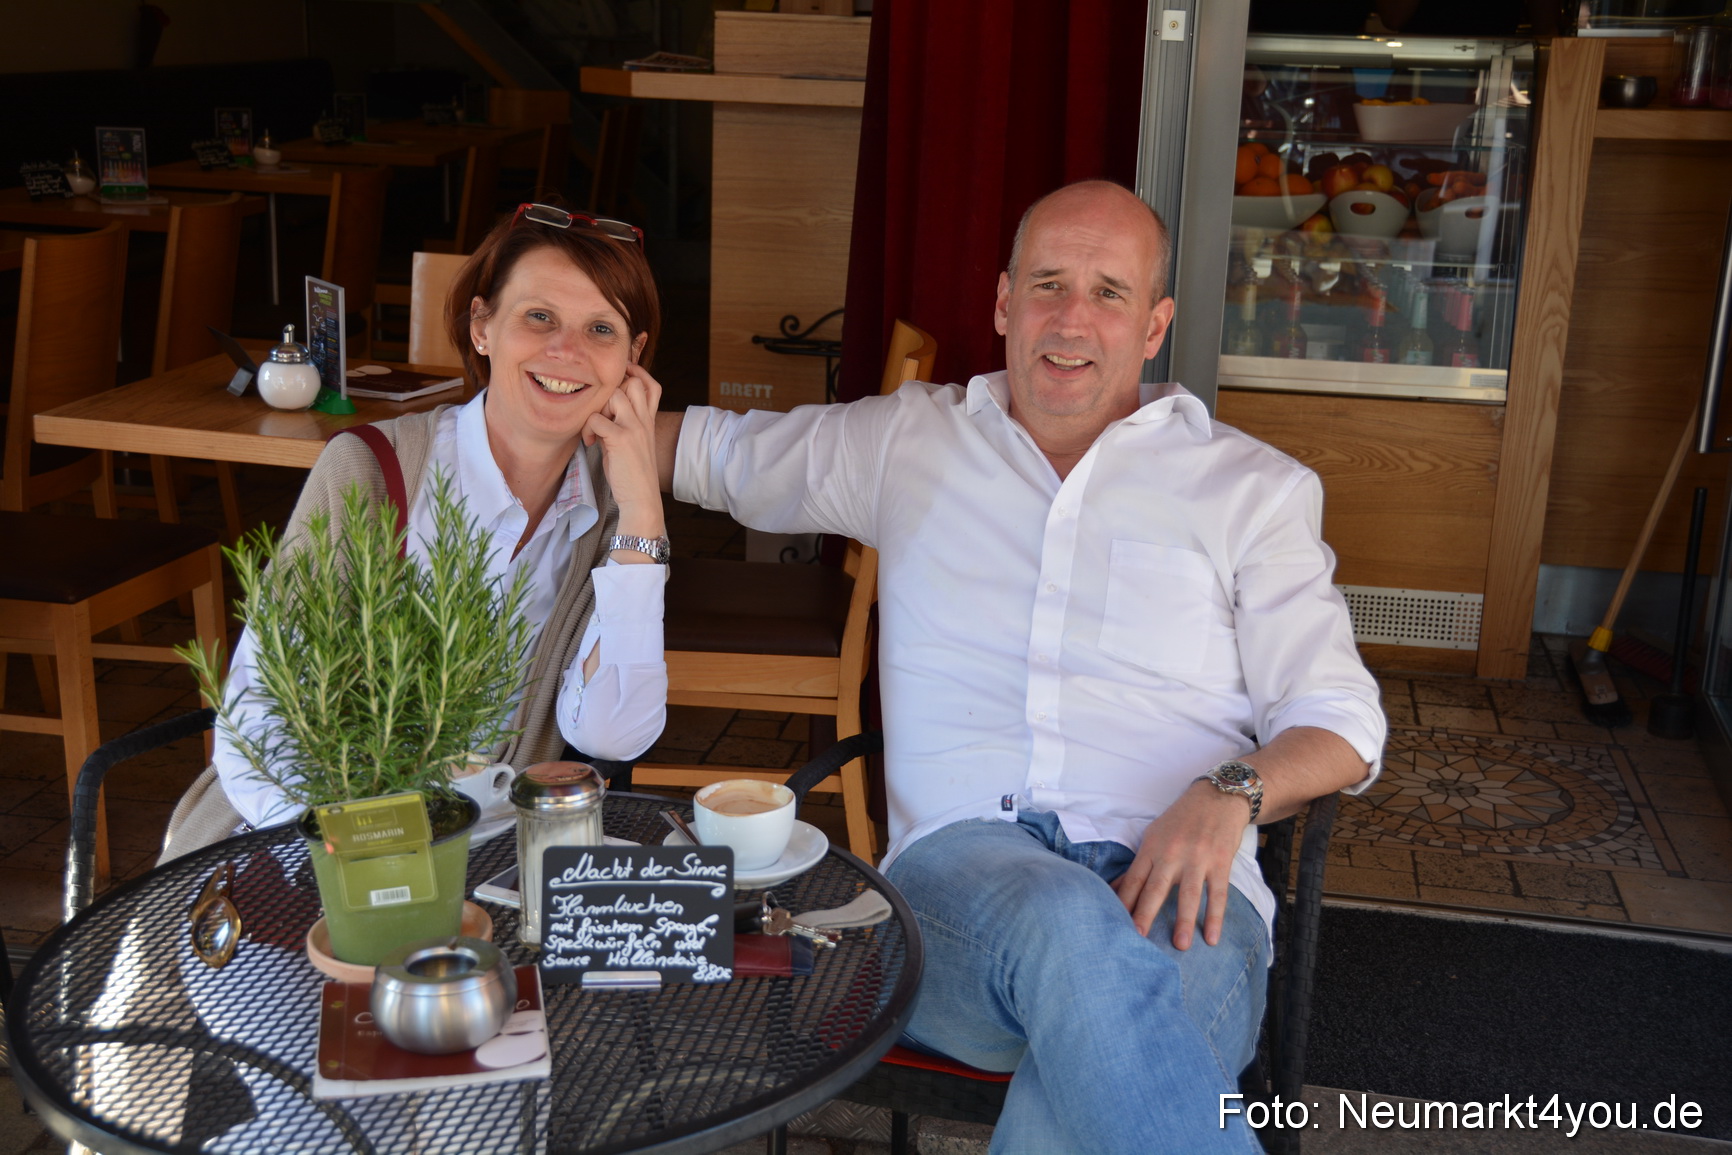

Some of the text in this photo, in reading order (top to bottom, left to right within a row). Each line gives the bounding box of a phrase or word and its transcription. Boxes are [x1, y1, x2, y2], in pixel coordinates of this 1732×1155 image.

[720, 382, 774, 399] BRETT
[352, 827, 405, 842] ROSMARIN
[563, 852, 728, 882] Nacht der Sinne
[549, 893, 684, 918] Flammkuchen
[550, 918, 575, 934] mit
[577, 917, 644, 939] frischem
[673, 936, 706, 950] und
[543, 954, 591, 968] Sauce
